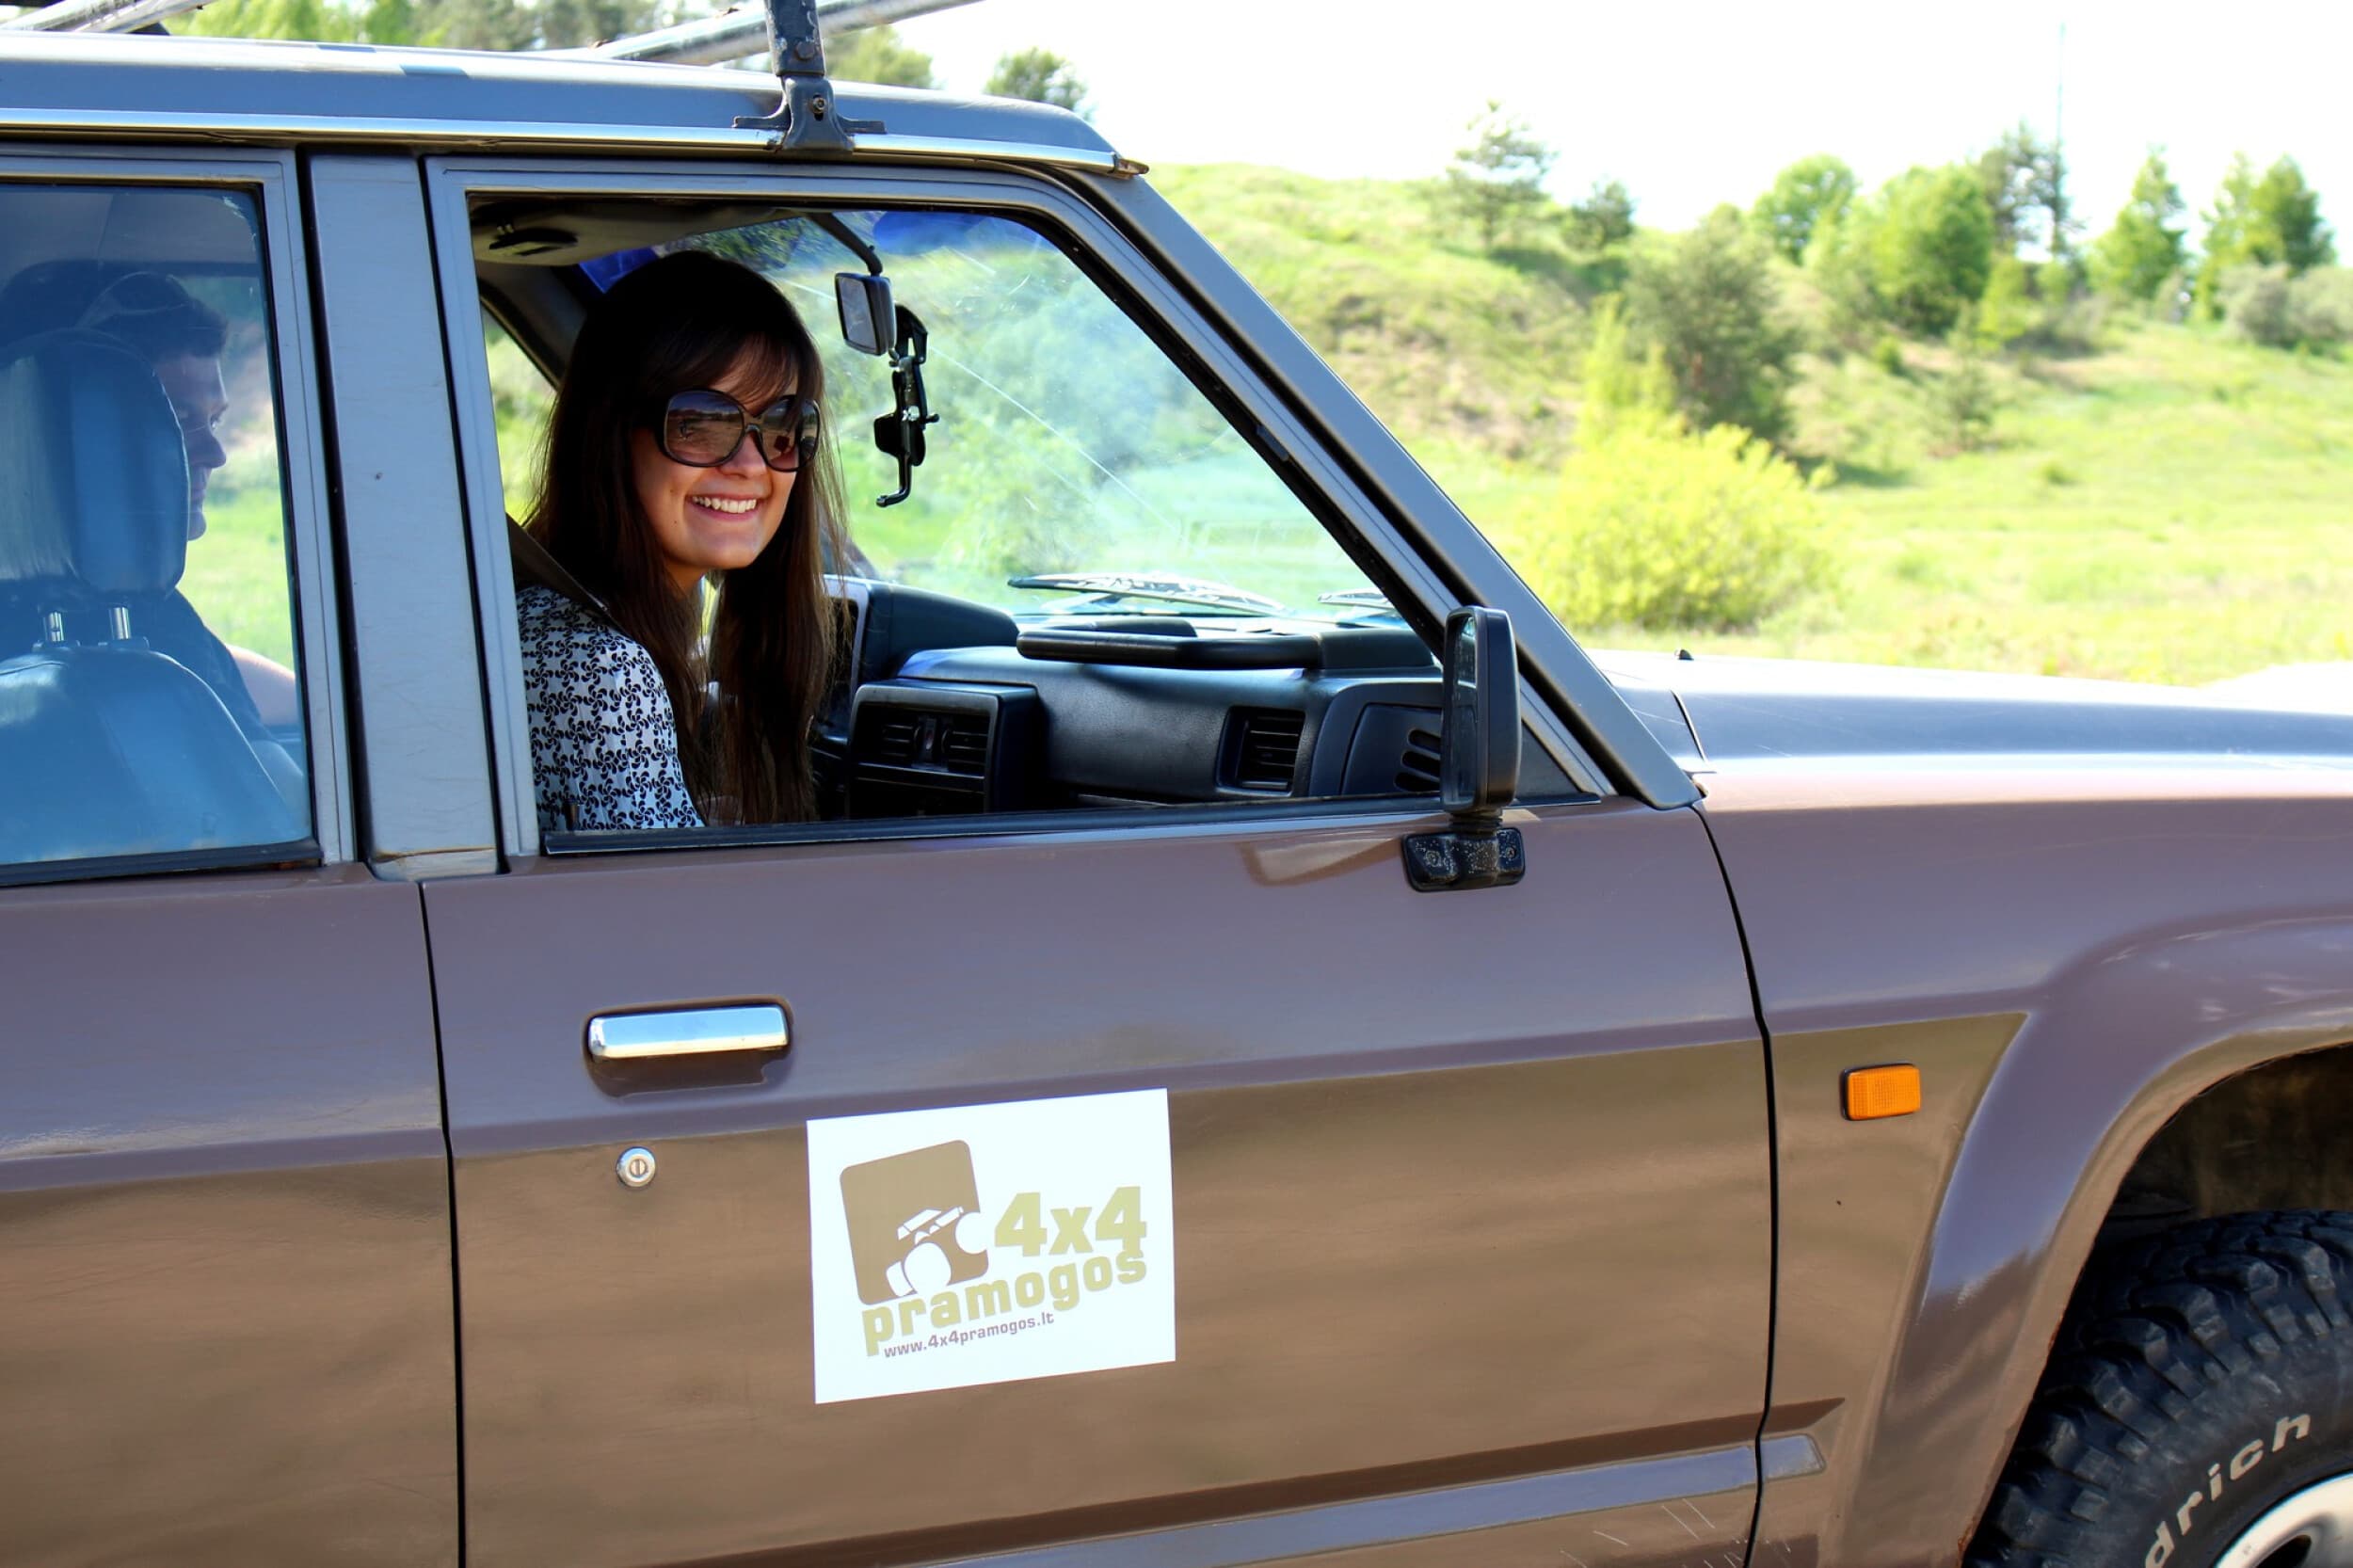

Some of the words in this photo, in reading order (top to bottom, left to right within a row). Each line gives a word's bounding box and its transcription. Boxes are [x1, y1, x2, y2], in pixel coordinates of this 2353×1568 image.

[994, 1186, 1147, 1257] 4x4
[861, 1249, 1147, 1357] pramogos
[884, 1312, 1054, 1358] www.4x4pramogos.lt
